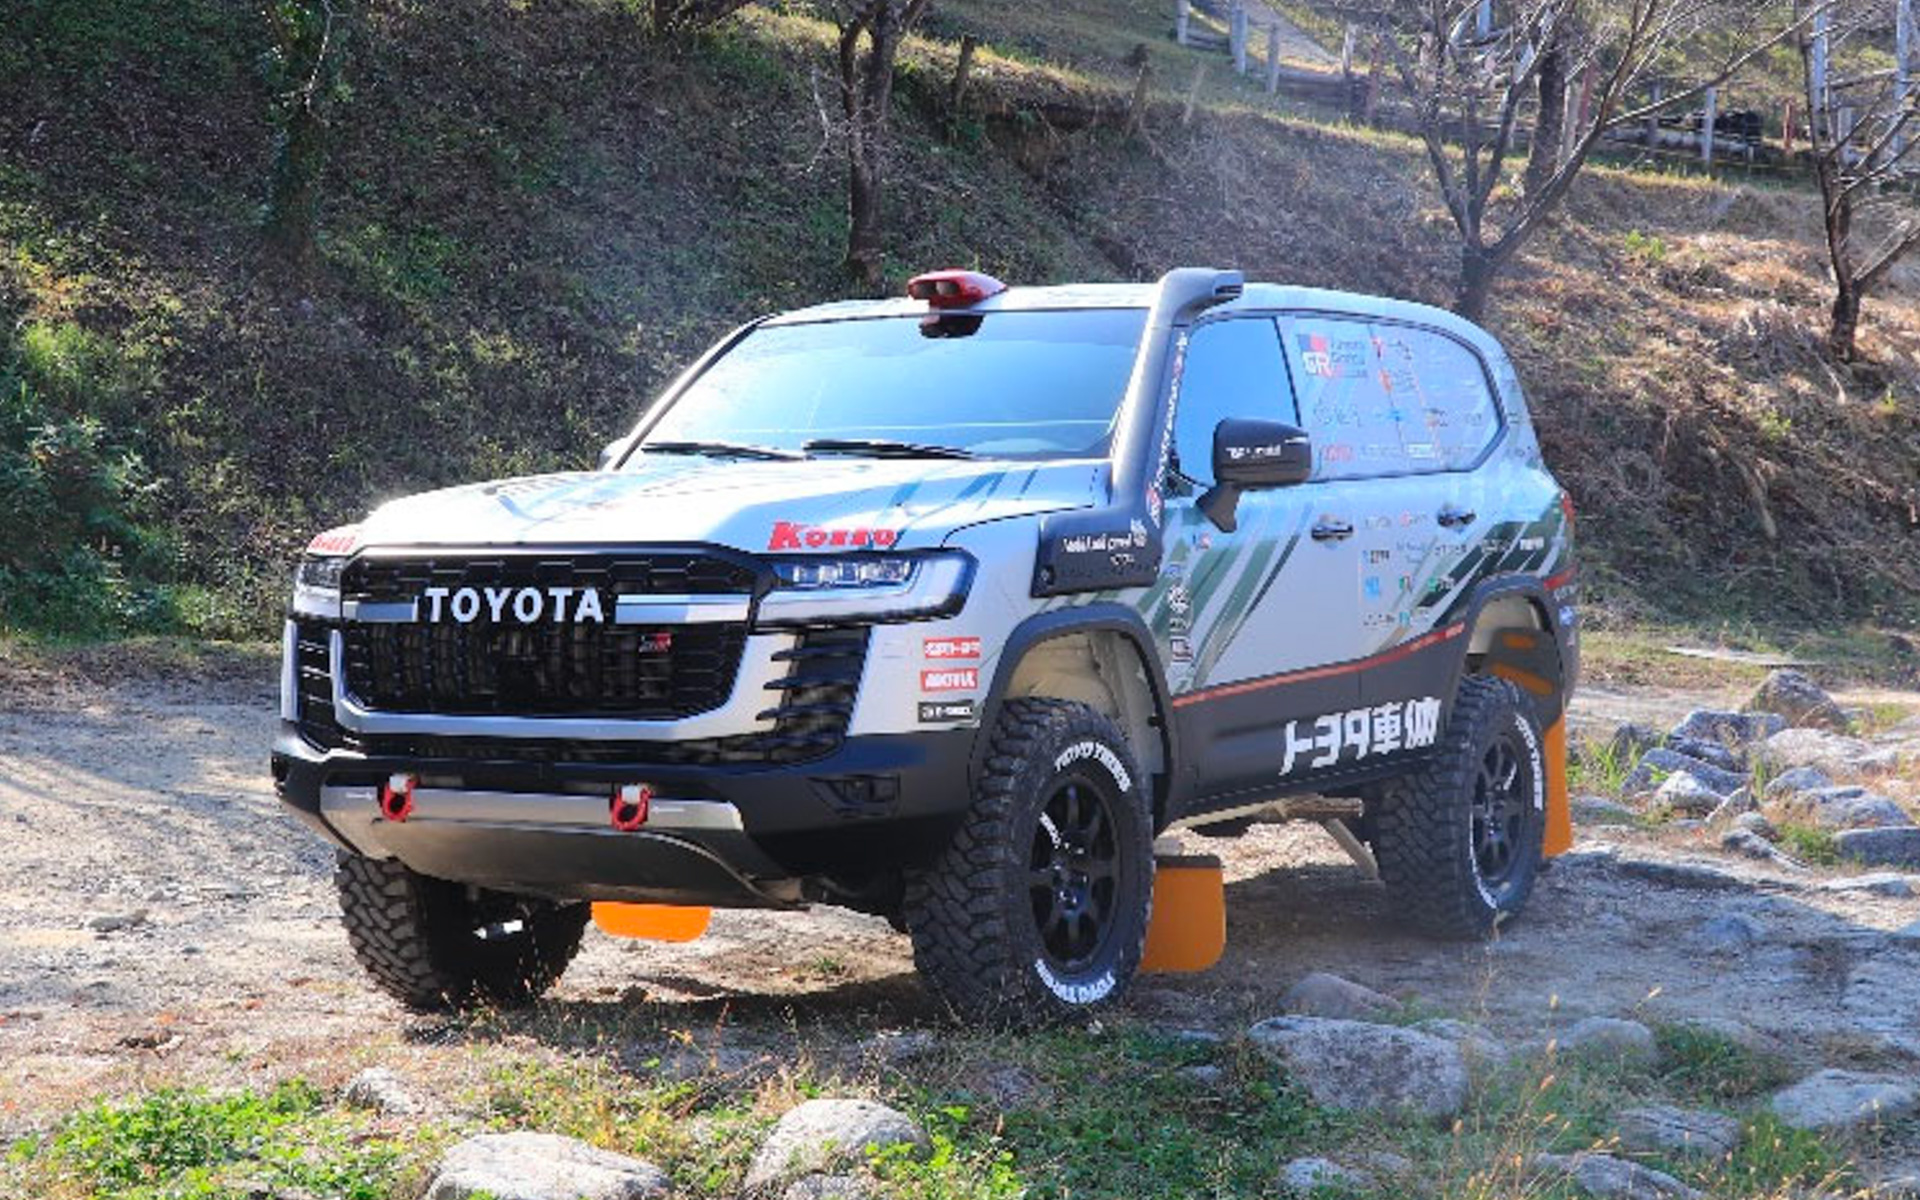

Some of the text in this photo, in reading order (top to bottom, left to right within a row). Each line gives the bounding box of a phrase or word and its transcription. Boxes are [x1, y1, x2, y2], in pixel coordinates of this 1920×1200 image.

[425, 587, 604, 624] TOYOTA
[1279, 696, 1443, 776] トヨタ車体
